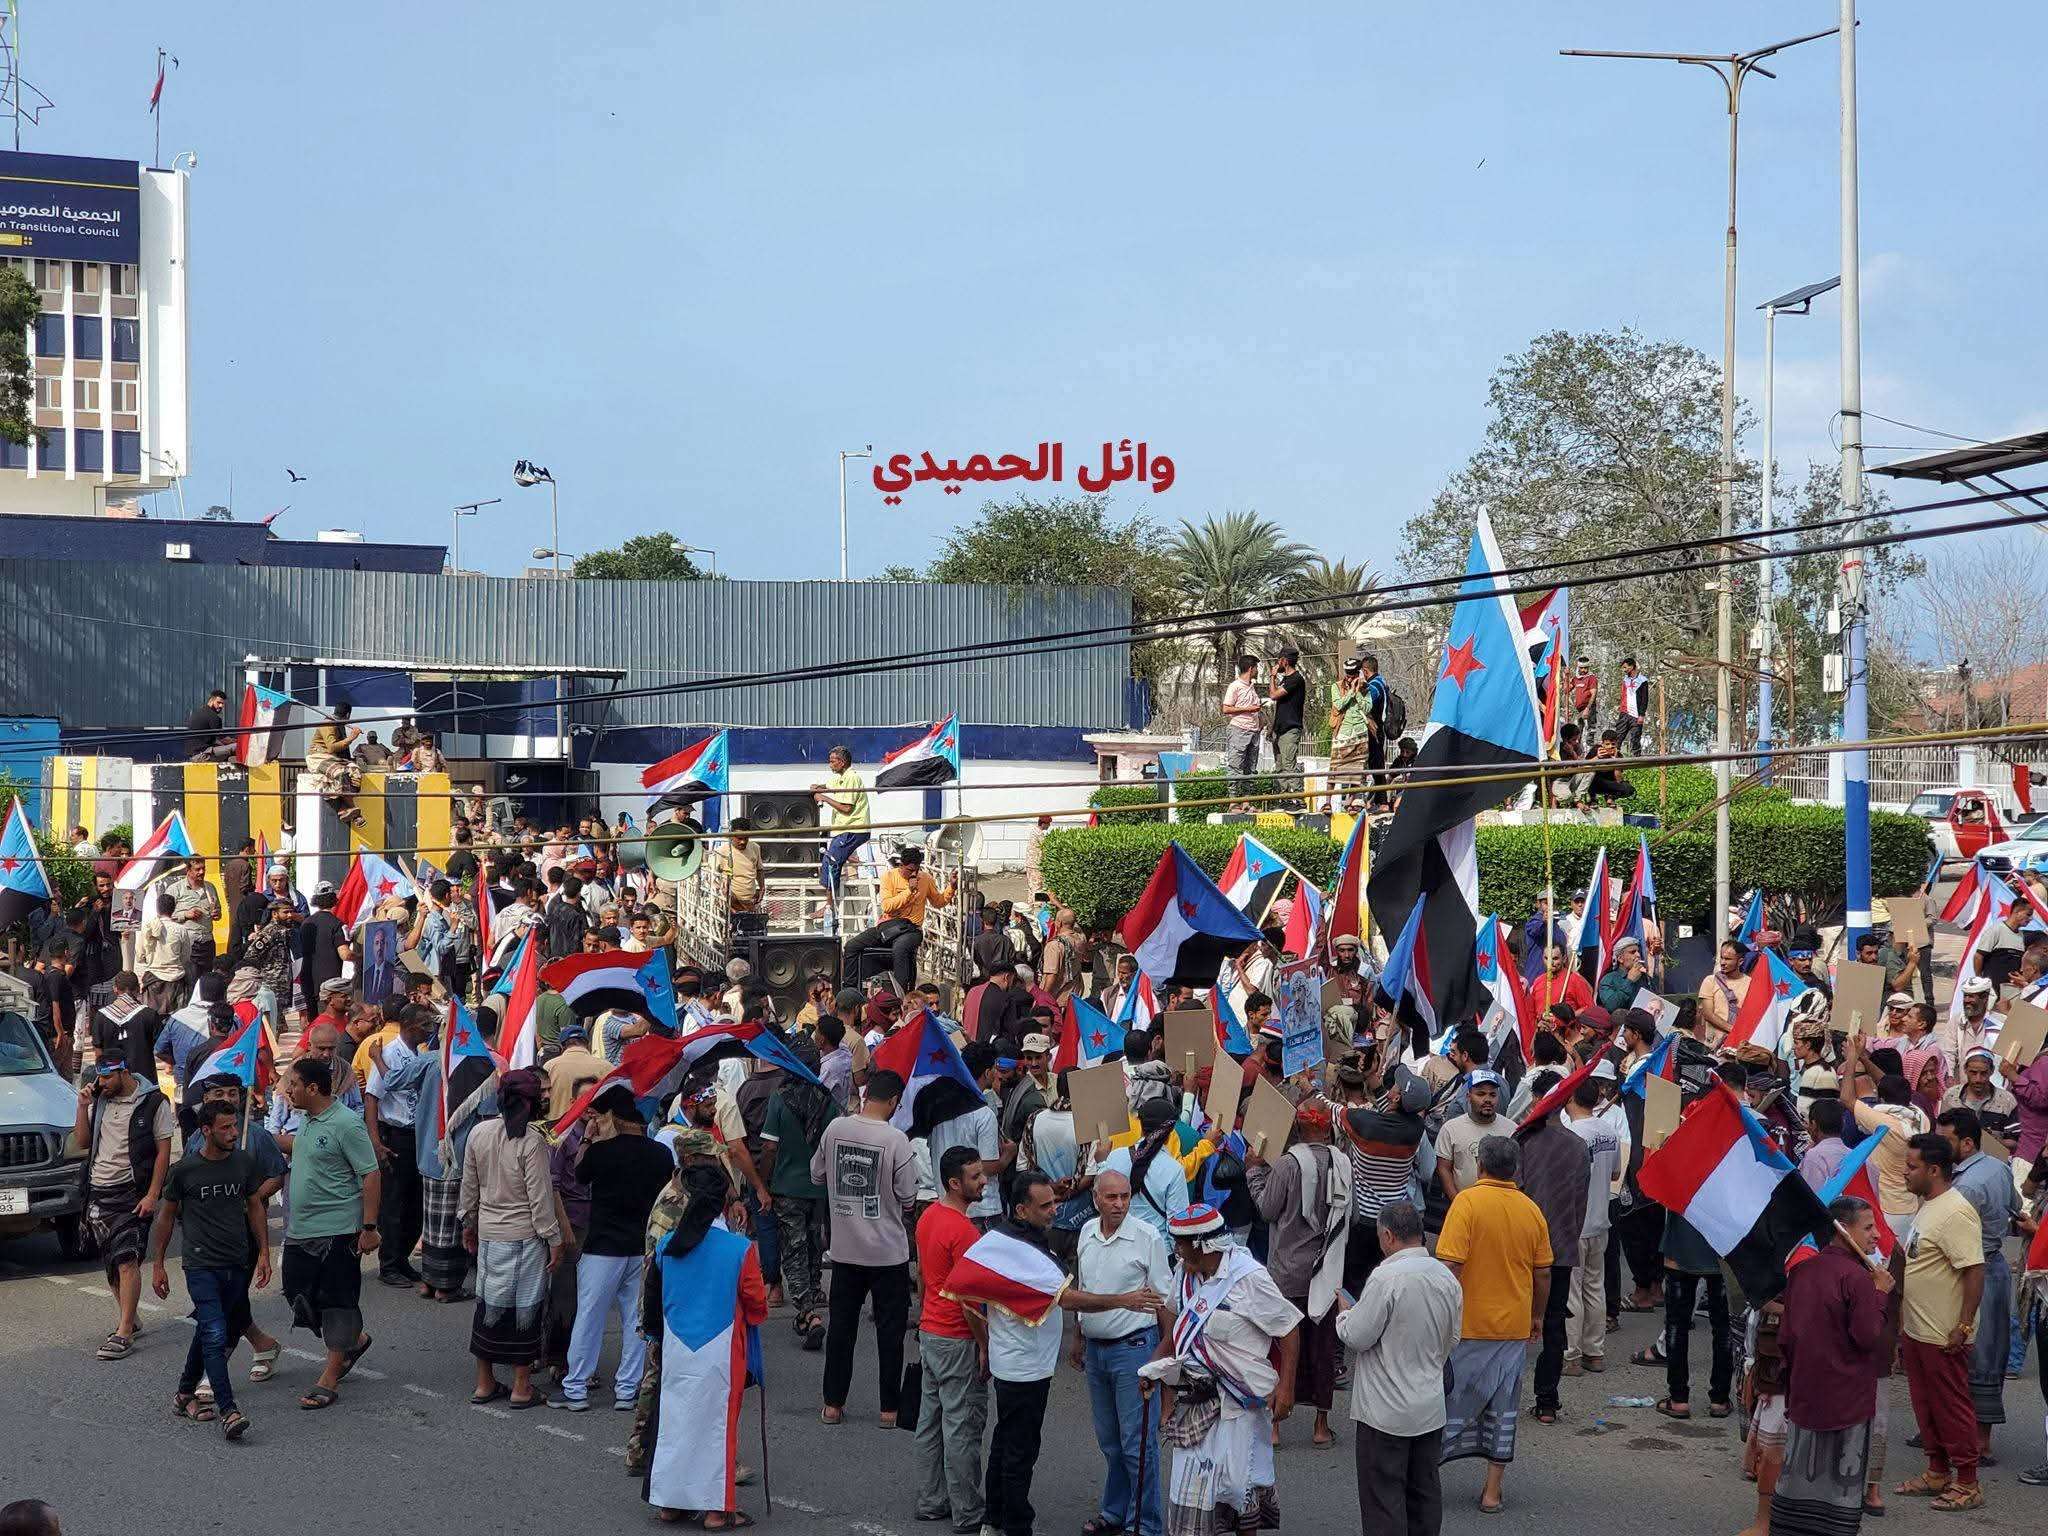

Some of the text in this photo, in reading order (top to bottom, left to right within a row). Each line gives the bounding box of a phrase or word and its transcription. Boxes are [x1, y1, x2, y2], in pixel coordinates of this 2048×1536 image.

[0, 205, 120, 223] الجمعية العمومي
[10, 221, 75, 234] Transitional
[78, 226, 120, 237] Council
[0, 1204, 13, 1212] 93
